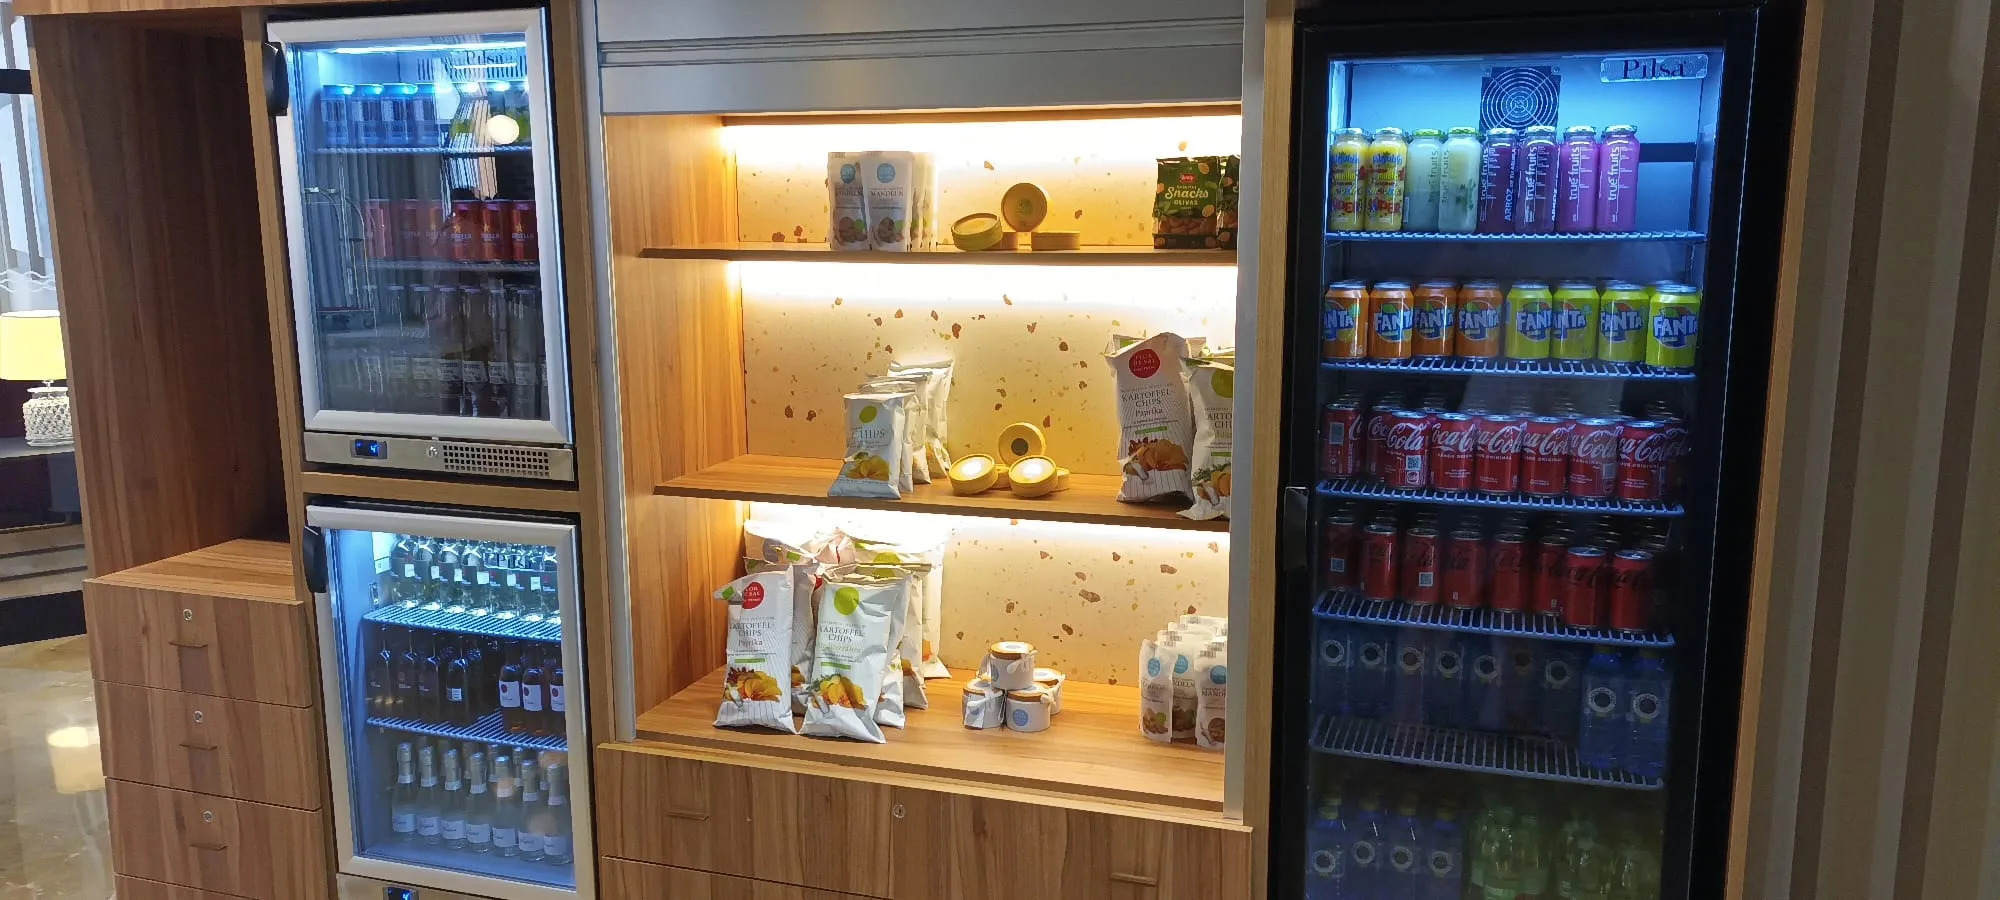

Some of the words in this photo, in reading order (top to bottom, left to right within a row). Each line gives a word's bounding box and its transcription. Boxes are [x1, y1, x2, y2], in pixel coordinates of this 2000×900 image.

[1623, 58, 1684, 79] Pilsa
[1525, 147, 1537, 176] fruits
[1568, 147, 1580, 175] fruits
[1607, 147, 1619, 175] fruits
[1165, 187, 1208, 199] Snacks
[1525, 177, 1535, 200] true
[1569, 177, 1578, 200] true
[1608, 177, 1617, 200] true
[1504, 188, 1514, 221] ARROZ
[1414, 308, 1453, 329] FANTA
[1517, 309, 1552, 331] FANT
[1601, 311, 1642, 331] FANTA
[1135, 398, 1161, 408] CHIPS
[1207, 412, 1233, 421] ARTO
[738, 629, 762, 637] CHIPS
[828, 633, 852, 643] CHIPS
